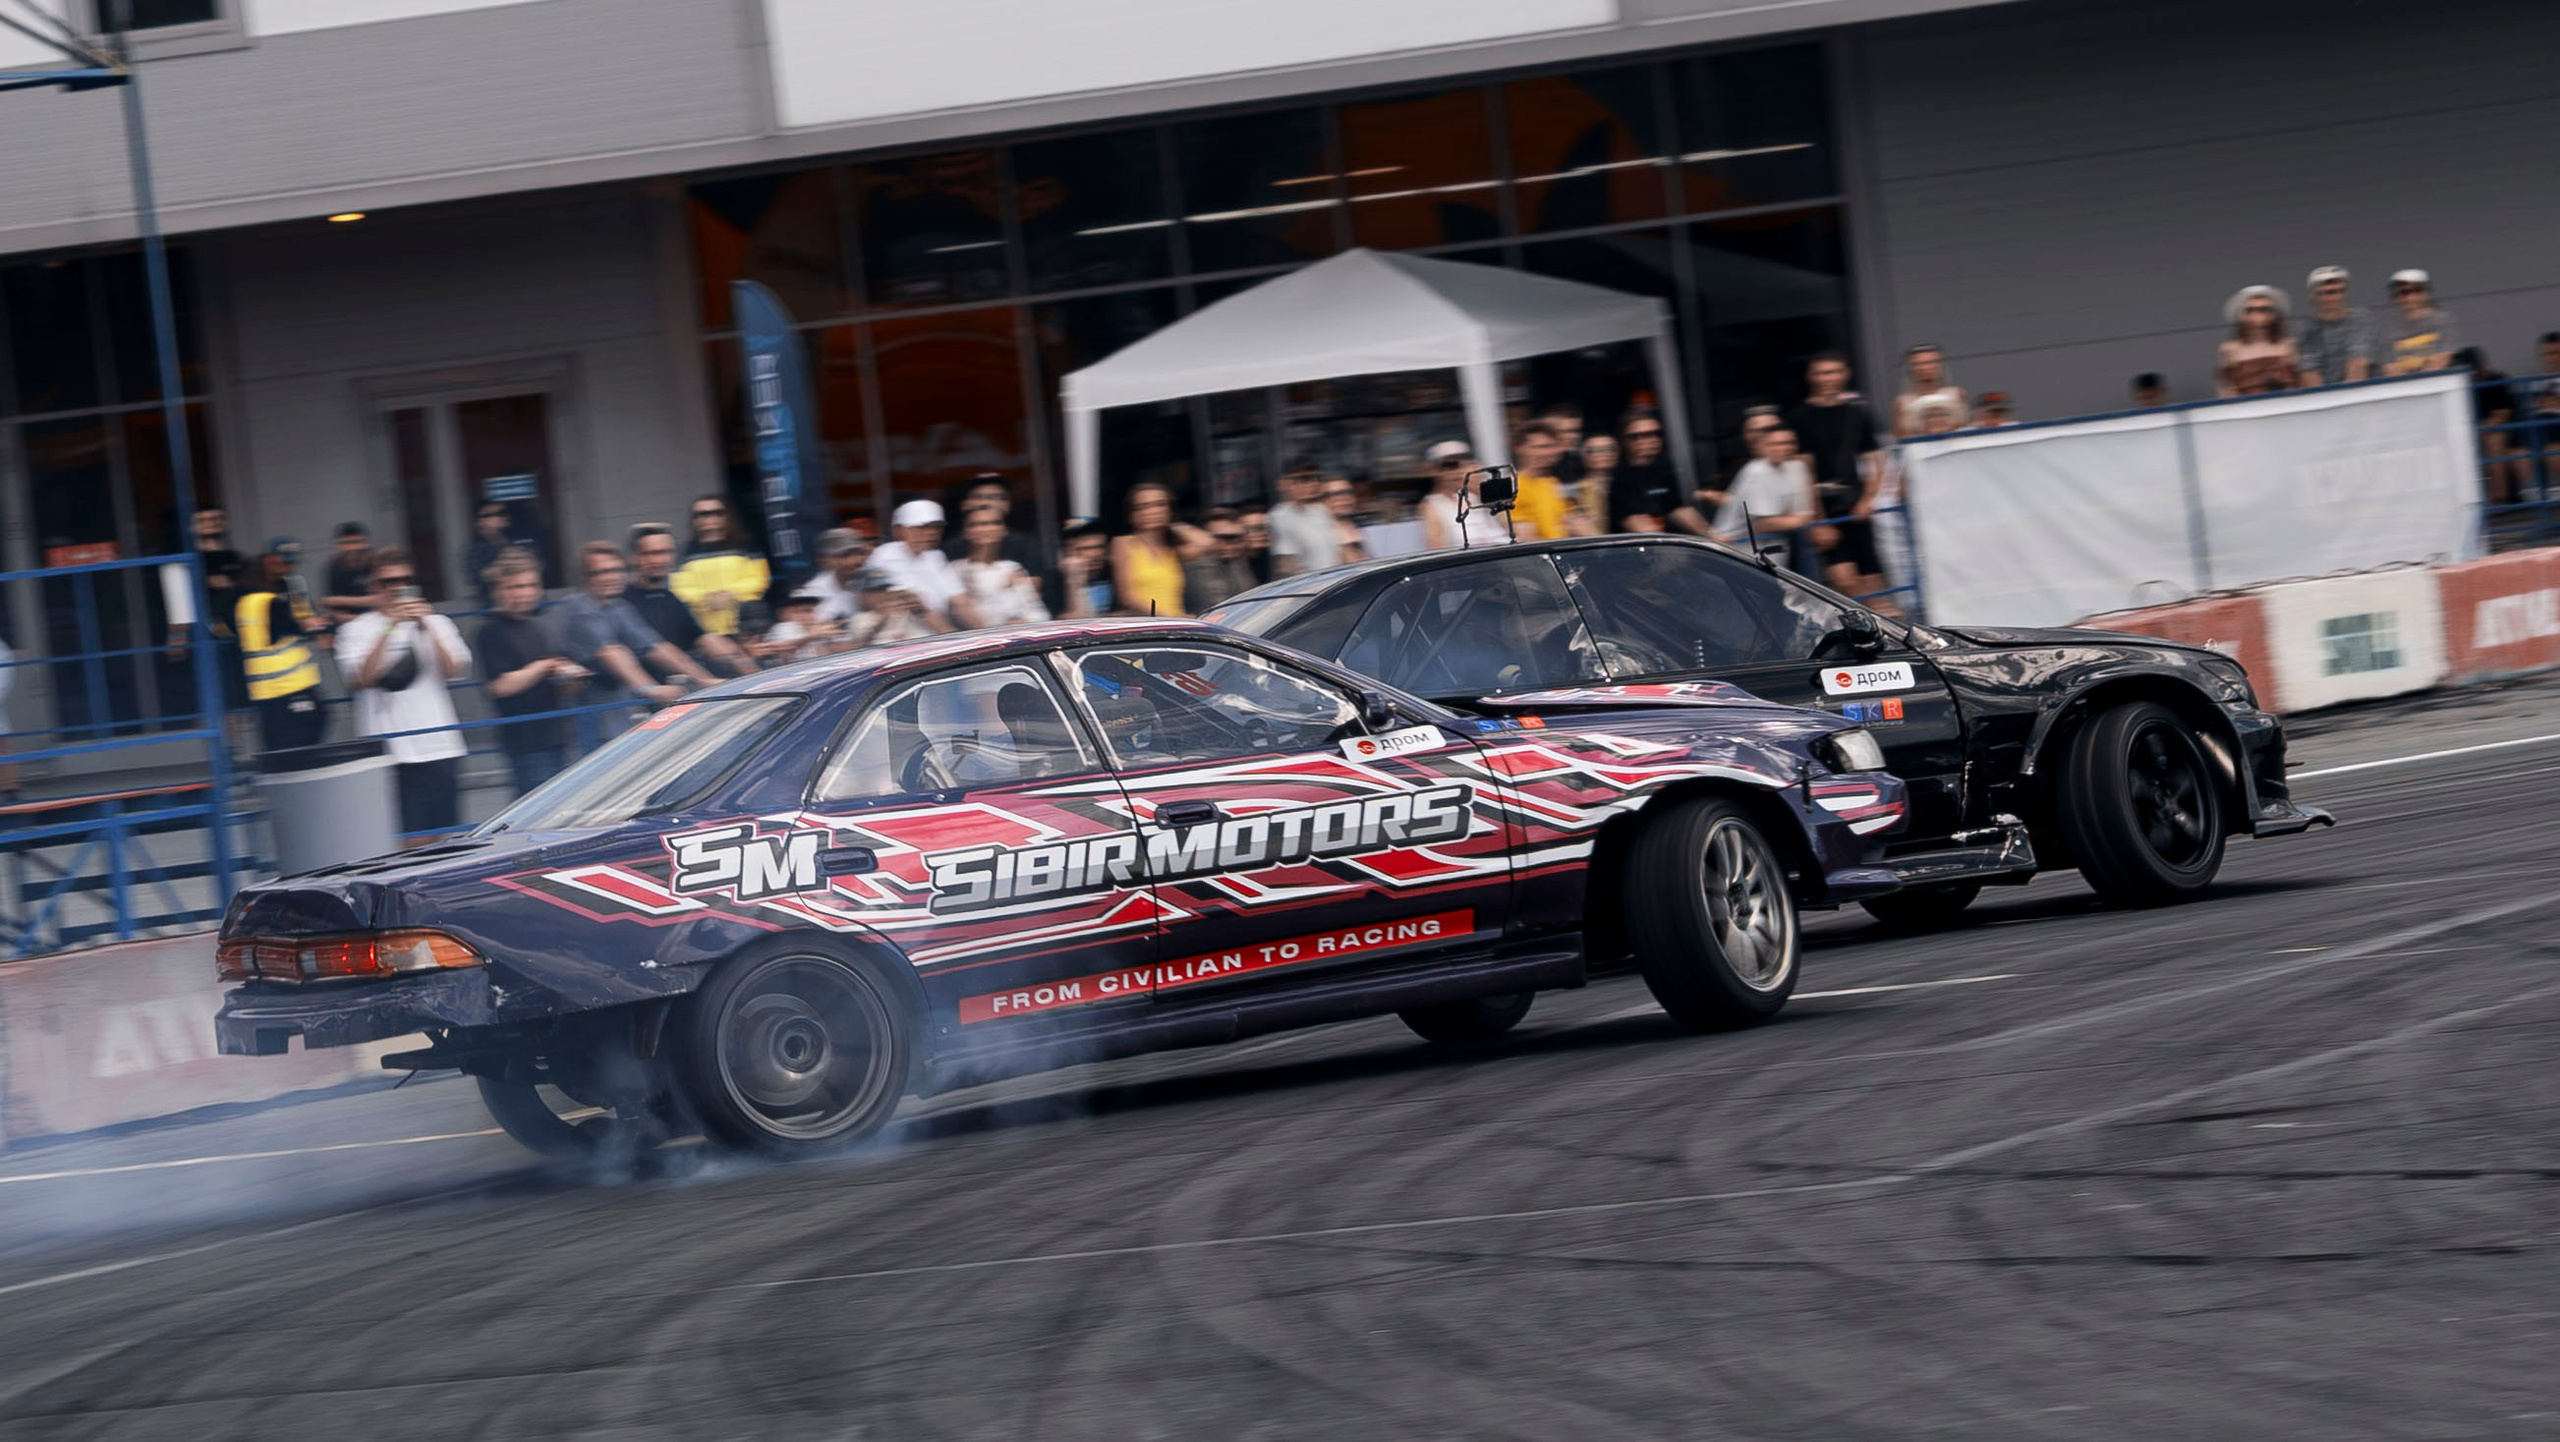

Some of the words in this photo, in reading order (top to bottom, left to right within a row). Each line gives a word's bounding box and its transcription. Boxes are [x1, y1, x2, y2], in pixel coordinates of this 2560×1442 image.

[1857, 670, 1902, 687] дром
[1845, 700, 1900, 720] SKR
[1380, 733, 1430, 751] дром
[671, 828, 818, 896] SM
[927, 835, 1137, 908] SIBIR
[1144, 788, 1462, 877] MOTORS
[992, 983, 1082, 1013] FROM
[1099, 953, 1242, 993] CIVILIAN
[1259, 943, 1300, 962] TO
[1317, 920, 1441, 953] RACING
